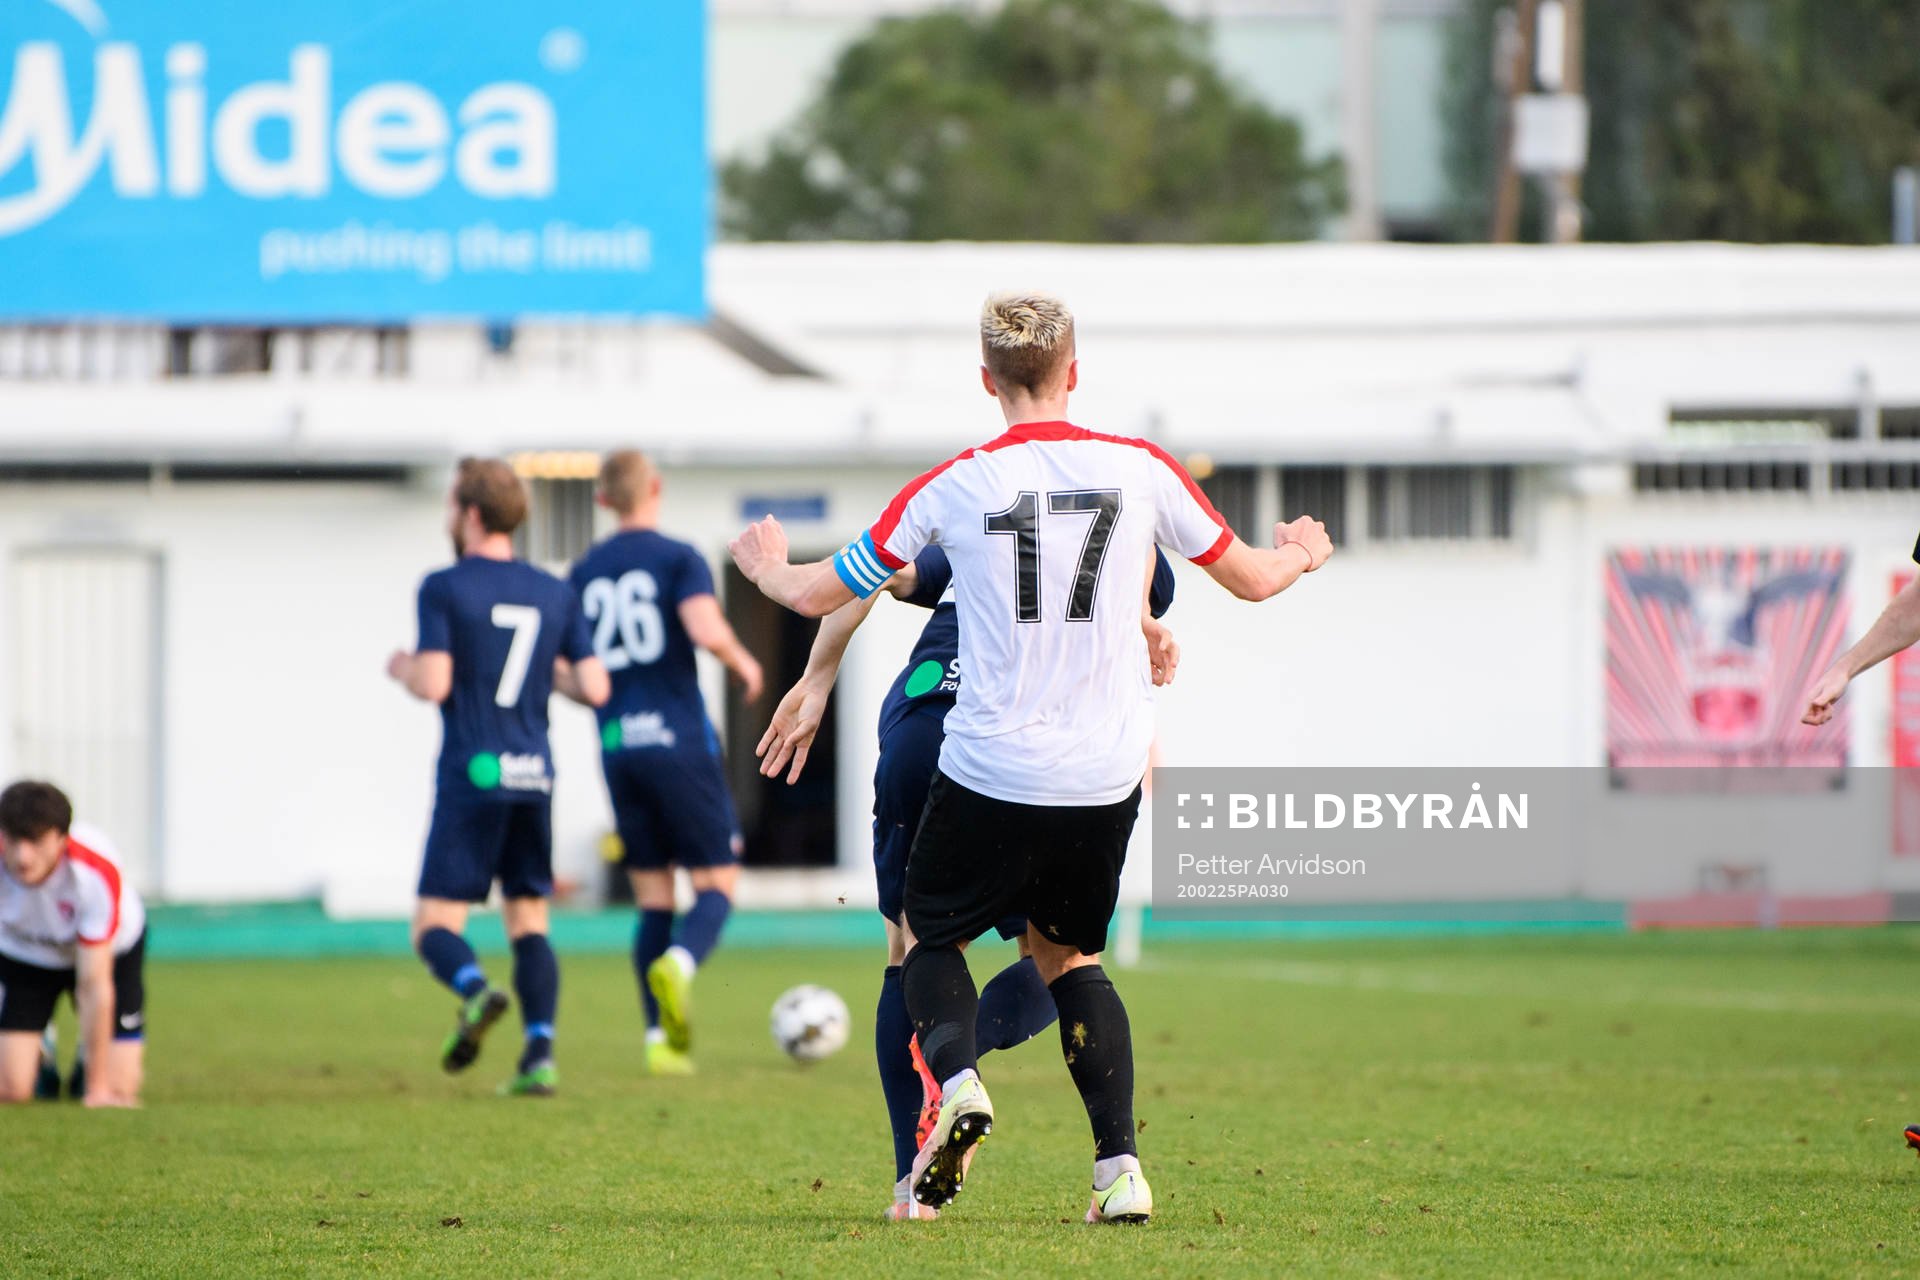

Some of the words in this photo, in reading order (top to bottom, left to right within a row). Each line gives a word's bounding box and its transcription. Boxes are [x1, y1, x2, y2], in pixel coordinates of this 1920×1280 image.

[0, 40, 558, 236] Midea
[260, 218, 452, 284] pushing
[458, 218, 537, 274] the
[541, 218, 652, 274] limit
[984, 488, 1122, 623] 17
[491, 603, 541, 708] 7
[583, 569, 666, 671] 26
